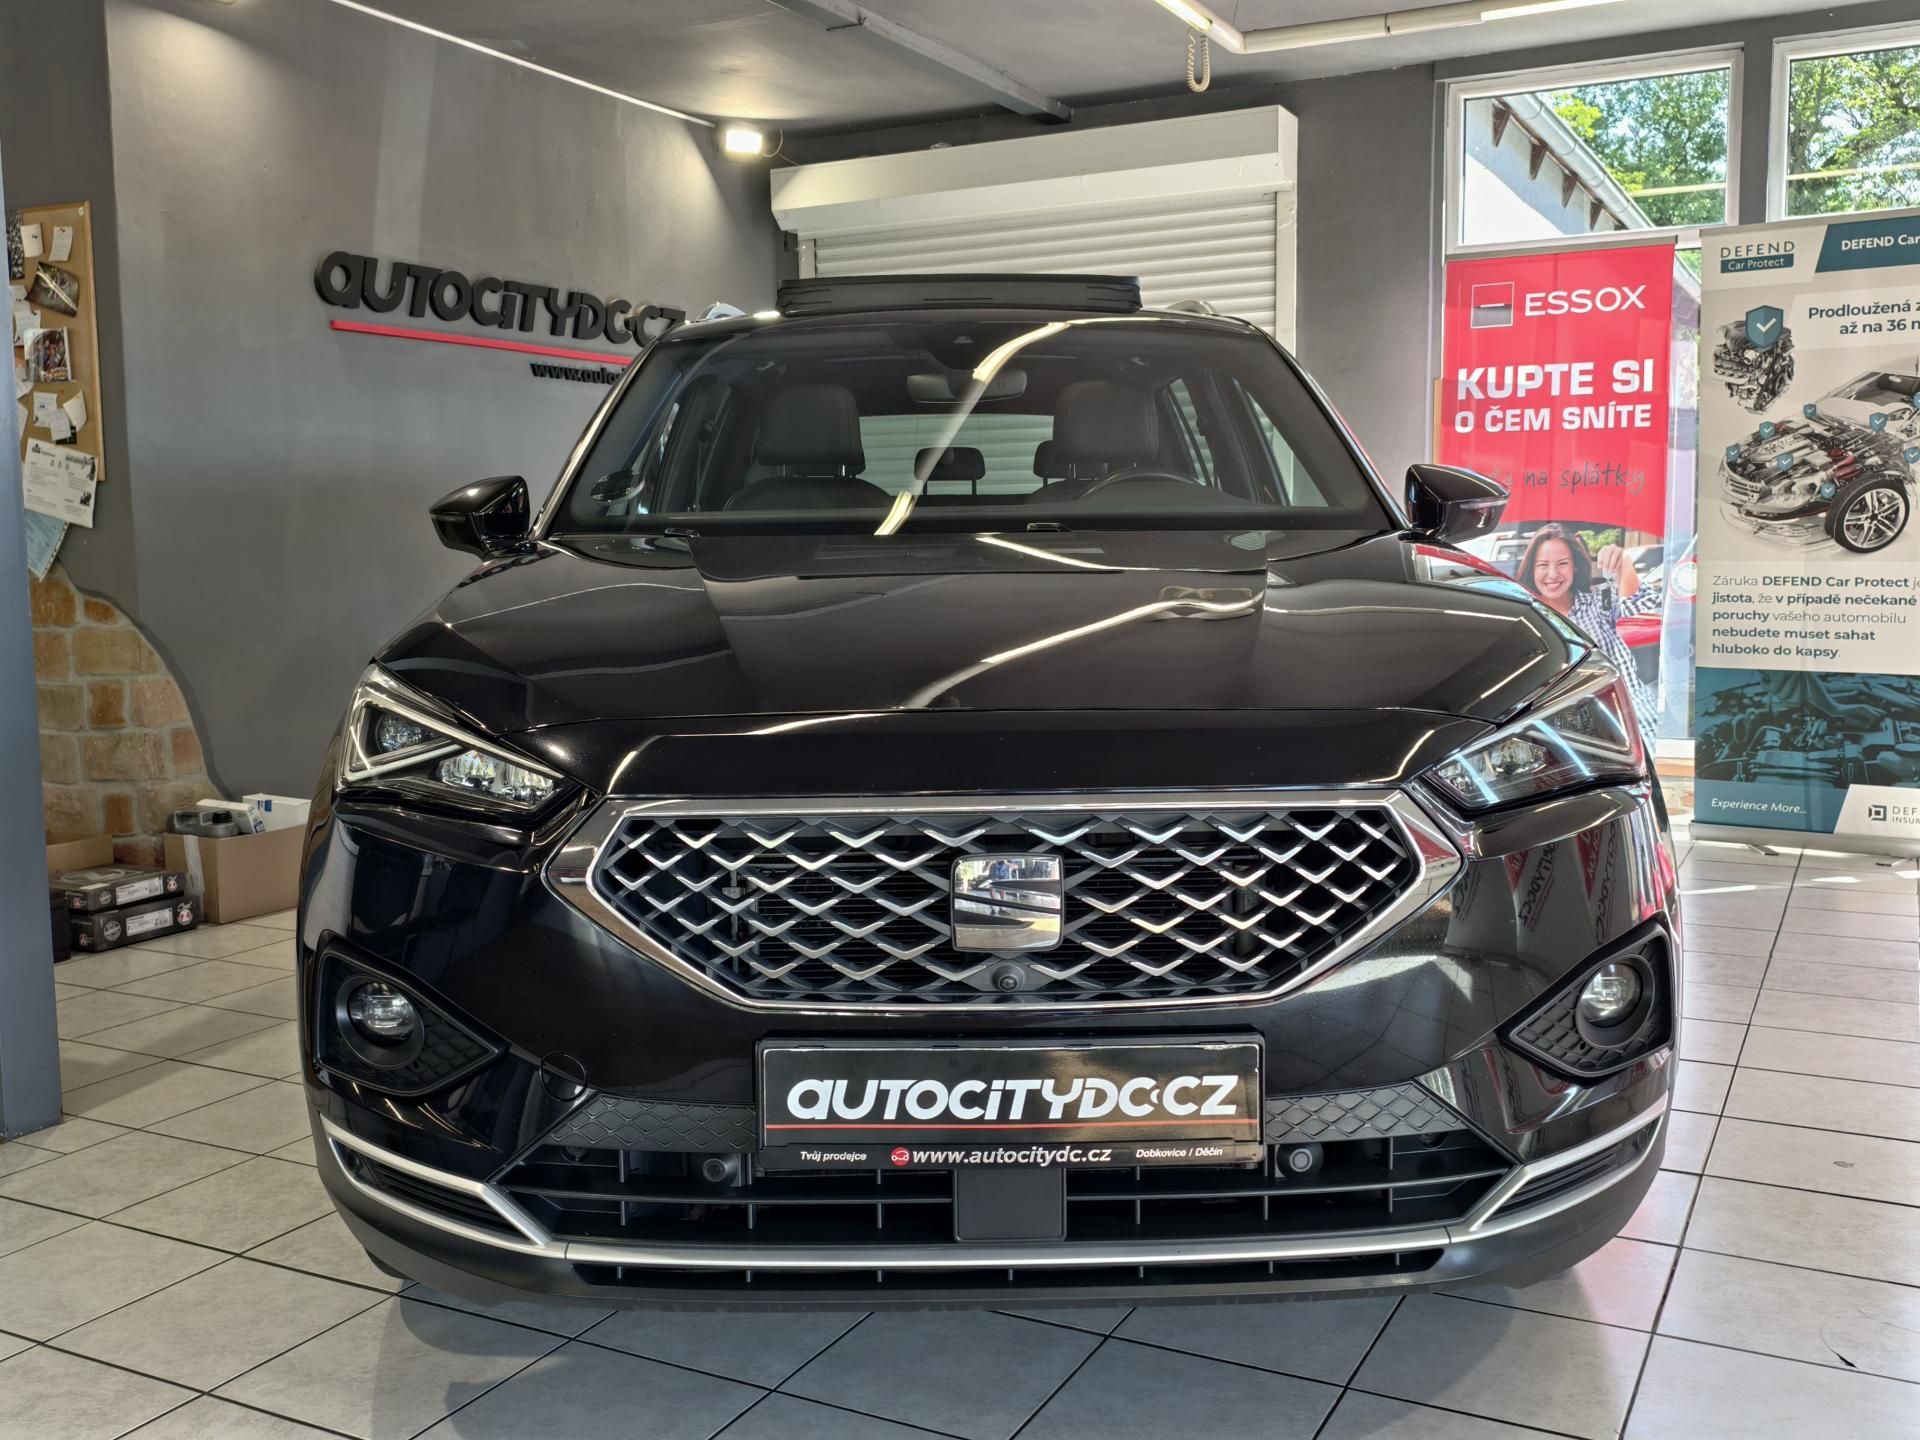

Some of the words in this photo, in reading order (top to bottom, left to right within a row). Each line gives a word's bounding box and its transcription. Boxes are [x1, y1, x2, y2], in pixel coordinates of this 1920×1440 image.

[1720, 241, 1795, 258] DEFEND
[1841, 236, 1894, 251] DEFEND
[1898, 234, 1920, 245] Car
[1728, 261, 1745, 270] Car
[1747, 258, 1785, 269] Protect
[1524, 285, 1647, 317] ESSOX
[1808, 299, 1911, 319] Prodloužená
[1840, 321, 1858, 334] až
[1862, 323, 1882, 333] na
[1886, 318, 1907, 331] 36
[1457, 362, 1594, 400] KUPTE
[1612, 359, 1654, 393] SI
[1455, 411, 1474, 433] O
[1484, 405, 1550, 432] ČEM
[1562, 400, 1652, 430] SNÍTE
[1525, 469, 1547, 486] na
[1712, 575, 1758, 586] Záruka
[1762, 576, 1822, 587] DEFEND
[1826, 576, 1850, 587] Car
[1854, 577, 1909, 587] Protect
[1711, 592, 1755, 604] jistota,
[1758, 593, 1772, 604] že
[1775, 595, 1783, 603] v
[1787, 593, 1840, 606] případě
[1845, 594, 1917, 606] nečekané
[1712, 610, 1770, 622] poruchy
[1773, 610, 1820, 622] vašeho
[1823, 612, 1906, 624] automobilu
[1712, 626, 1780, 638] nebudete
[1784, 630, 1830, 640] muset
[1834, 629, 1876, 640] sahat
[1712, 643, 1770, 655] hluboko
[1773, 645, 1792, 655] do
[1795, 645, 1841, 659] kapsy.
[1711, 798, 1768, 811] Experience
[800, 1150, 821, 1162] Tvůj
[823, 1151, 867, 1162] prodejce
[912, 1145, 1112, 1167] www.autocitydc.cz
[1136, 1149, 1187, 1159] Dobkovice
[1195, 1146, 1223, 1157] Děčín
